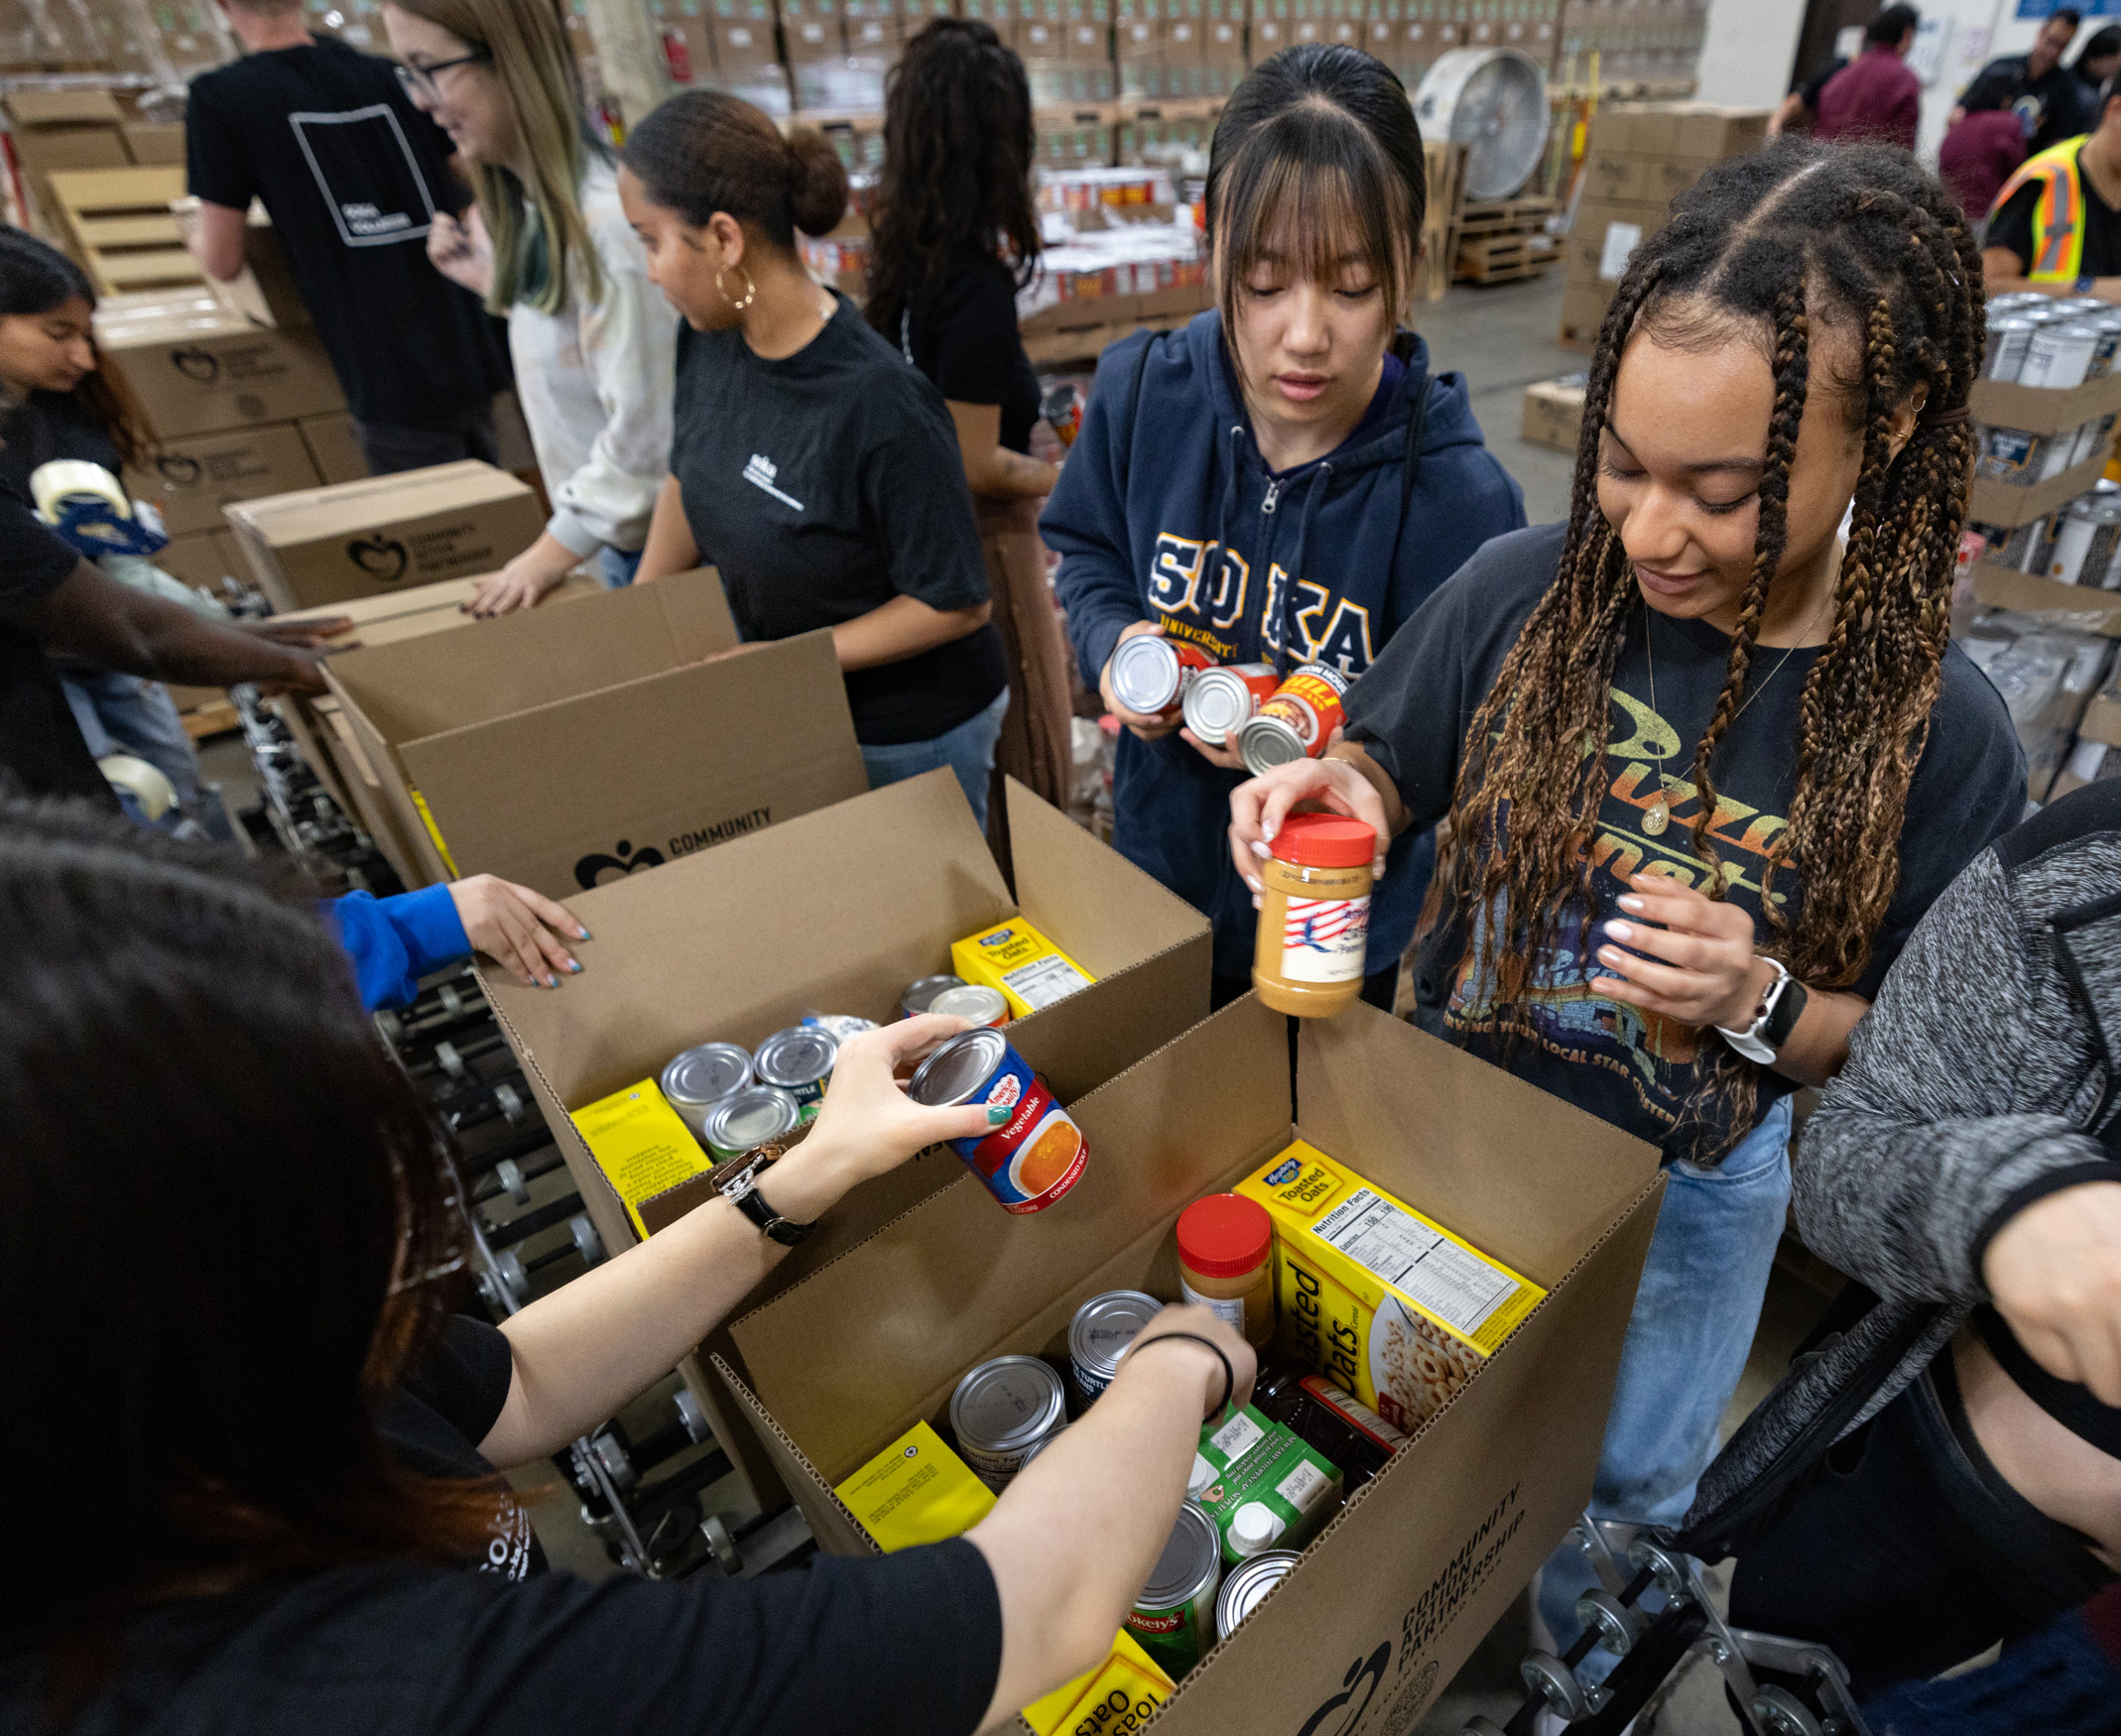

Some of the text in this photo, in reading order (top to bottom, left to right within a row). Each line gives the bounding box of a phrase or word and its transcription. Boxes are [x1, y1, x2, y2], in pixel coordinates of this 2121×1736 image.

[1322, 670, 1348, 694] HOUS
[669, 806, 771, 856] COMMUNITY
[987, 937, 1030, 957] Toasted
[1003, 947, 1029, 959] Oats
[1003, 964, 1037, 981] Nutrition
[1543, 1038, 1587, 1064] LOCAL
[1592, 1053, 1630, 1079] STAR
[989, 1076, 1016, 1106] American
[1001, 1096, 1041, 1141] Vegetable
[1049, 1148, 1087, 1199] CONDENSED SOUP
[1279, 1168, 1325, 1201] Toasted
[1300, 1181, 1329, 1202] Oats
[1312, 1204, 1349, 1234] Nutrition
[1346, 1188, 1370, 1207] Facts
[1339, 1203, 1396, 1251] Calories 150 190
[1287, 1260, 1320, 1365] asted
[1350, 1304, 1360, 1330] Cereal
[1324, 1318, 1358, 1398] Oats
[1004, 1453, 1025, 1463] Fact
[1268, 1433, 1283, 1448] Twist
[1209, 1434, 1297, 1519] NEW EASY TO OPEN CAP NO PULL TA
[1402, 1480, 1521, 1633] COMMUNITY
[1398, 1509, 1526, 1674] PARTNERSHIP
[1401, 1557, 1472, 1652] ACTION
[1433, 1602, 1466, 1644] FOOD
[1471, 1557, 1502, 1596] BANK
[1128, 1614, 1179, 1630] okely's
[1075, 1689, 1130, 1736] Oats
